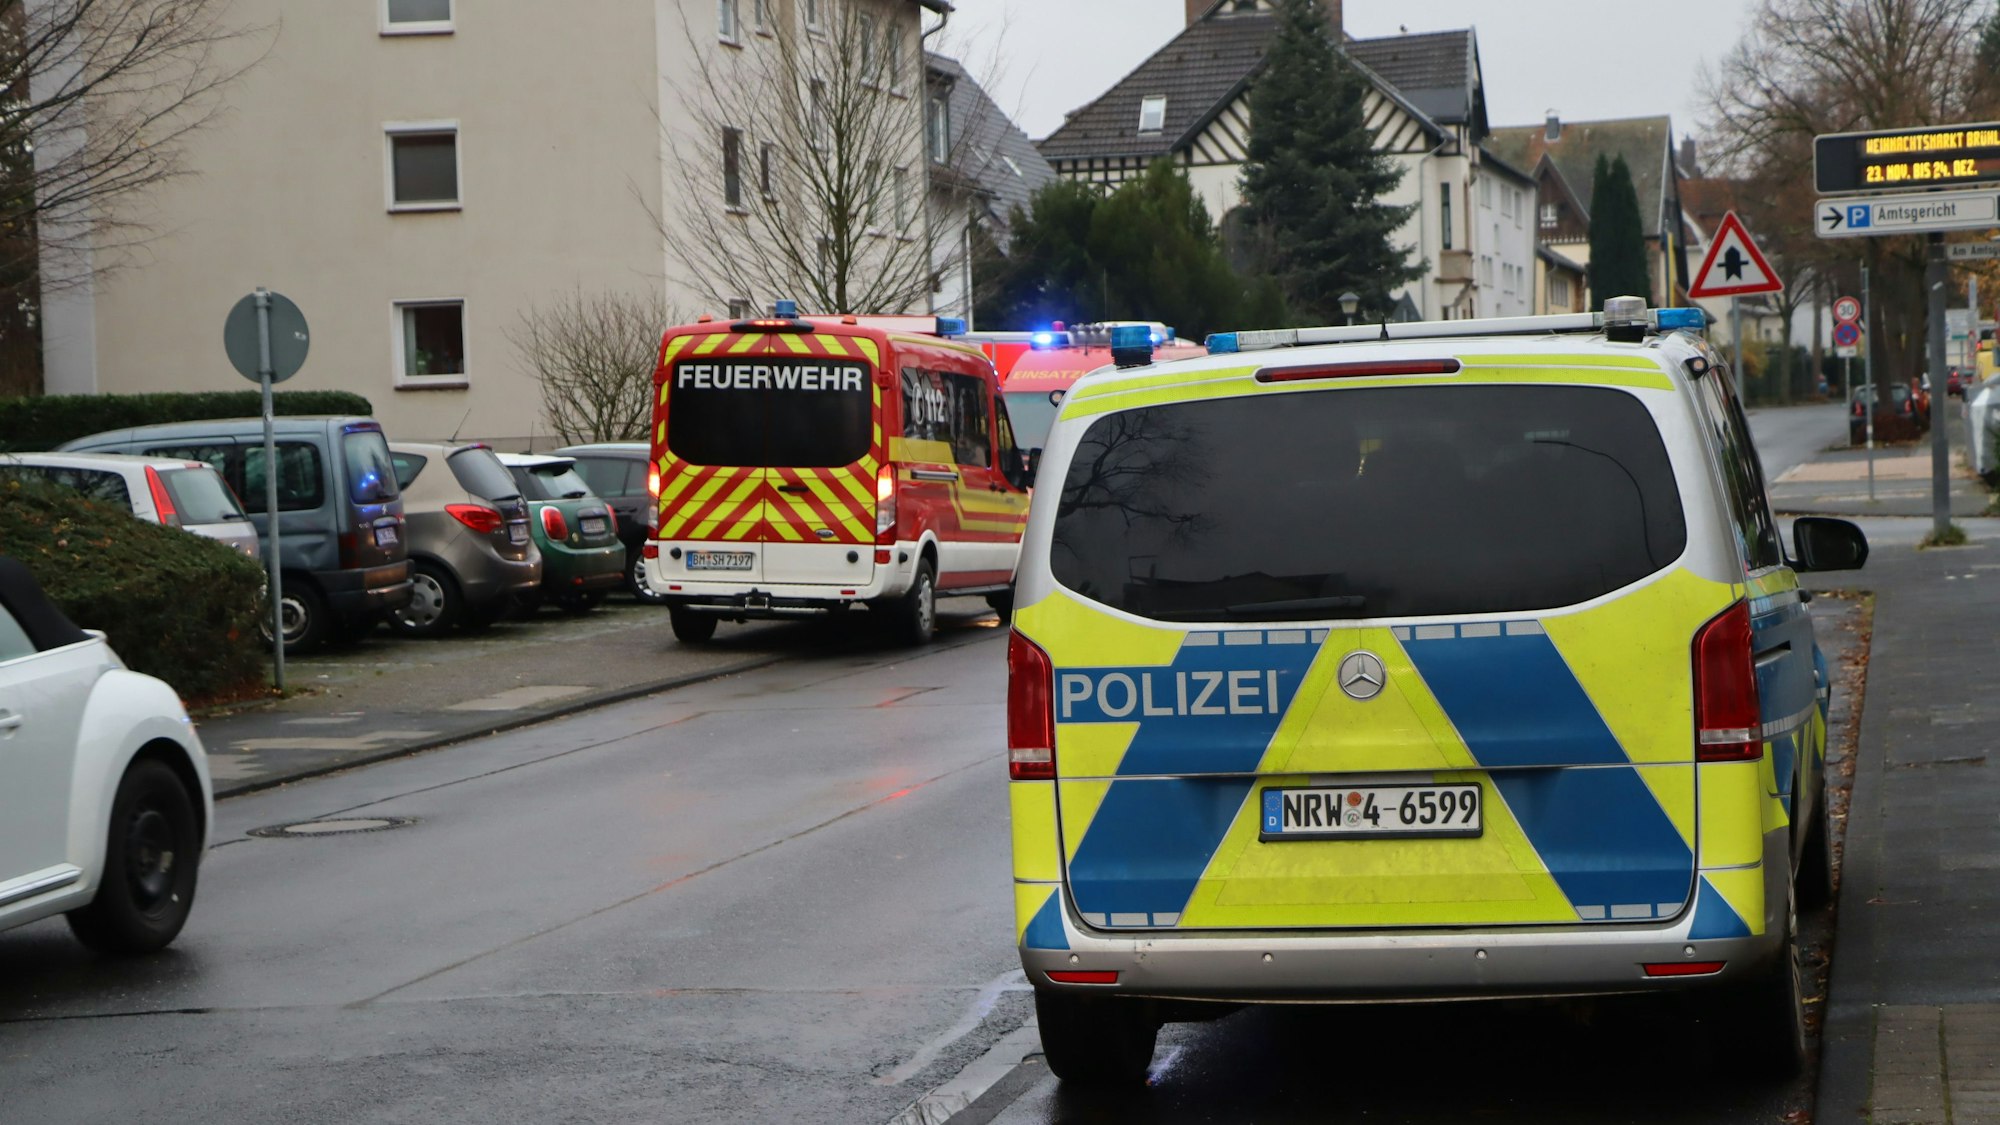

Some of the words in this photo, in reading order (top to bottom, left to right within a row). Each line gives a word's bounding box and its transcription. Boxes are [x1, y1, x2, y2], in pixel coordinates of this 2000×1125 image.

[1866, 165, 1884, 182] 23.
[1886, 163, 1911, 181] NOV.
[1913, 161, 1931, 179] BIS
[1933, 160, 1951, 179] 24.
[1953, 158, 1978, 177] DEZ.
[1852, 208, 1865, 225] P
[1878, 202, 1956, 223] Amtsgericht
[1840, 304, 1855, 316] 30
[678, 365, 863, 391] FEUERWEHR
[925, 388, 945, 423] 112
[693, 552, 705, 566] BM
[712, 553, 725, 566] SH
[727, 552, 751, 566] 7197
[1061, 669, 1279, 718] POLIZEI
[1283, 793, 1343, 827] NRW
[1363, 790, 1477, 826] 4-6599
[1269, 816, 1277, 826] D
